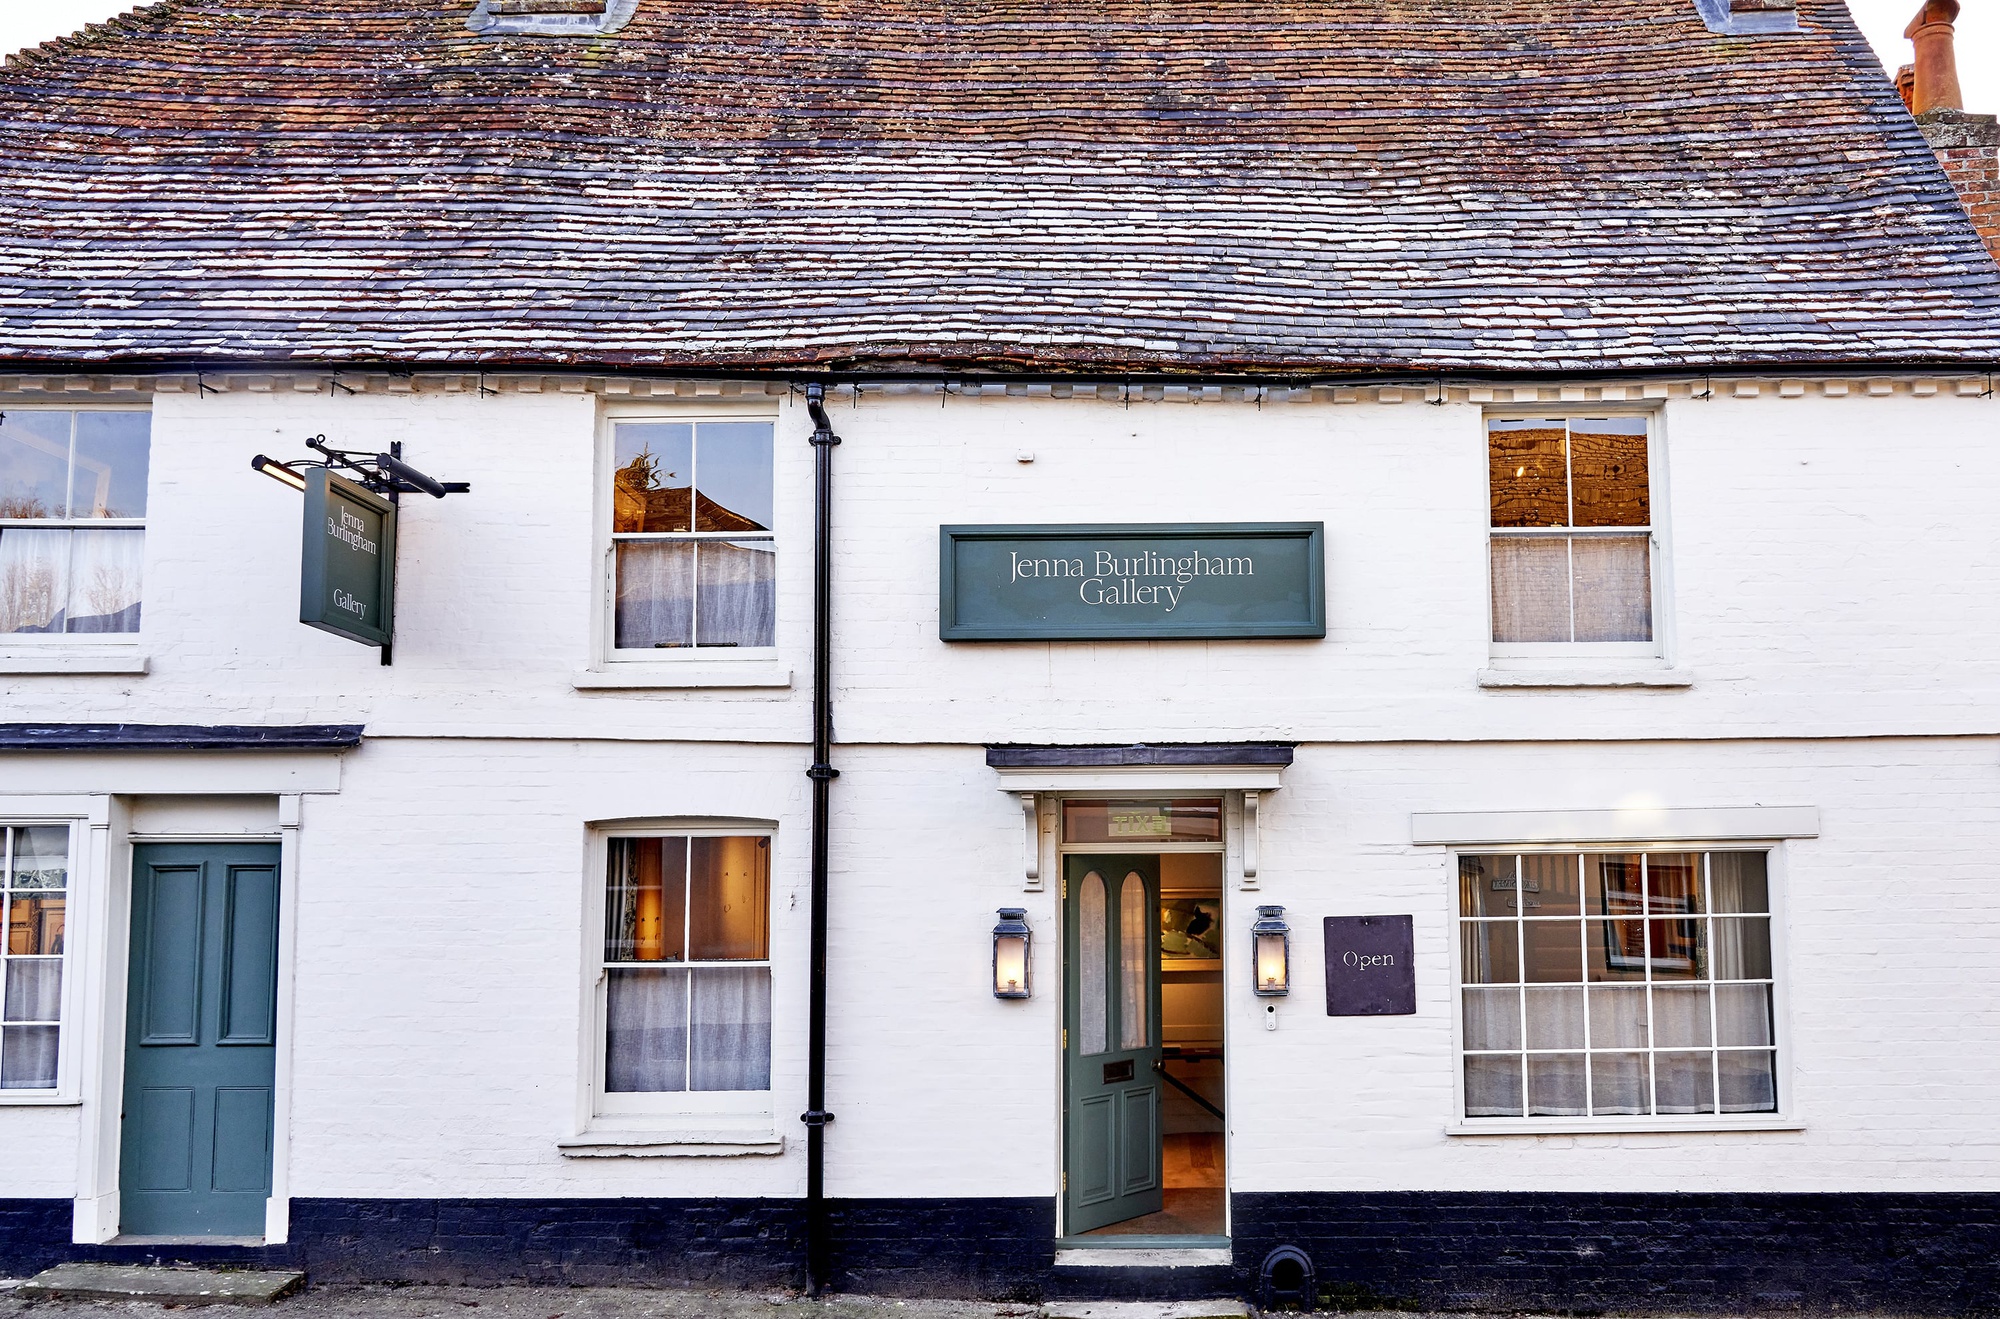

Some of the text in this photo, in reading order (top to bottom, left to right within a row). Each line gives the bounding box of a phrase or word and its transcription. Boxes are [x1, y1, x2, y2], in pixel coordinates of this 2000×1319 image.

[327, 517, 377, 554] Burlingham
[340, 506, 364, 532] Jenna
[1009, 550, 1254, 584] Jenna Burlingham
[333, 588, 367, 620] Gallery
[1079, 578, 1185, 612] Gallery
[1343, 950, 1395, 971] Open
